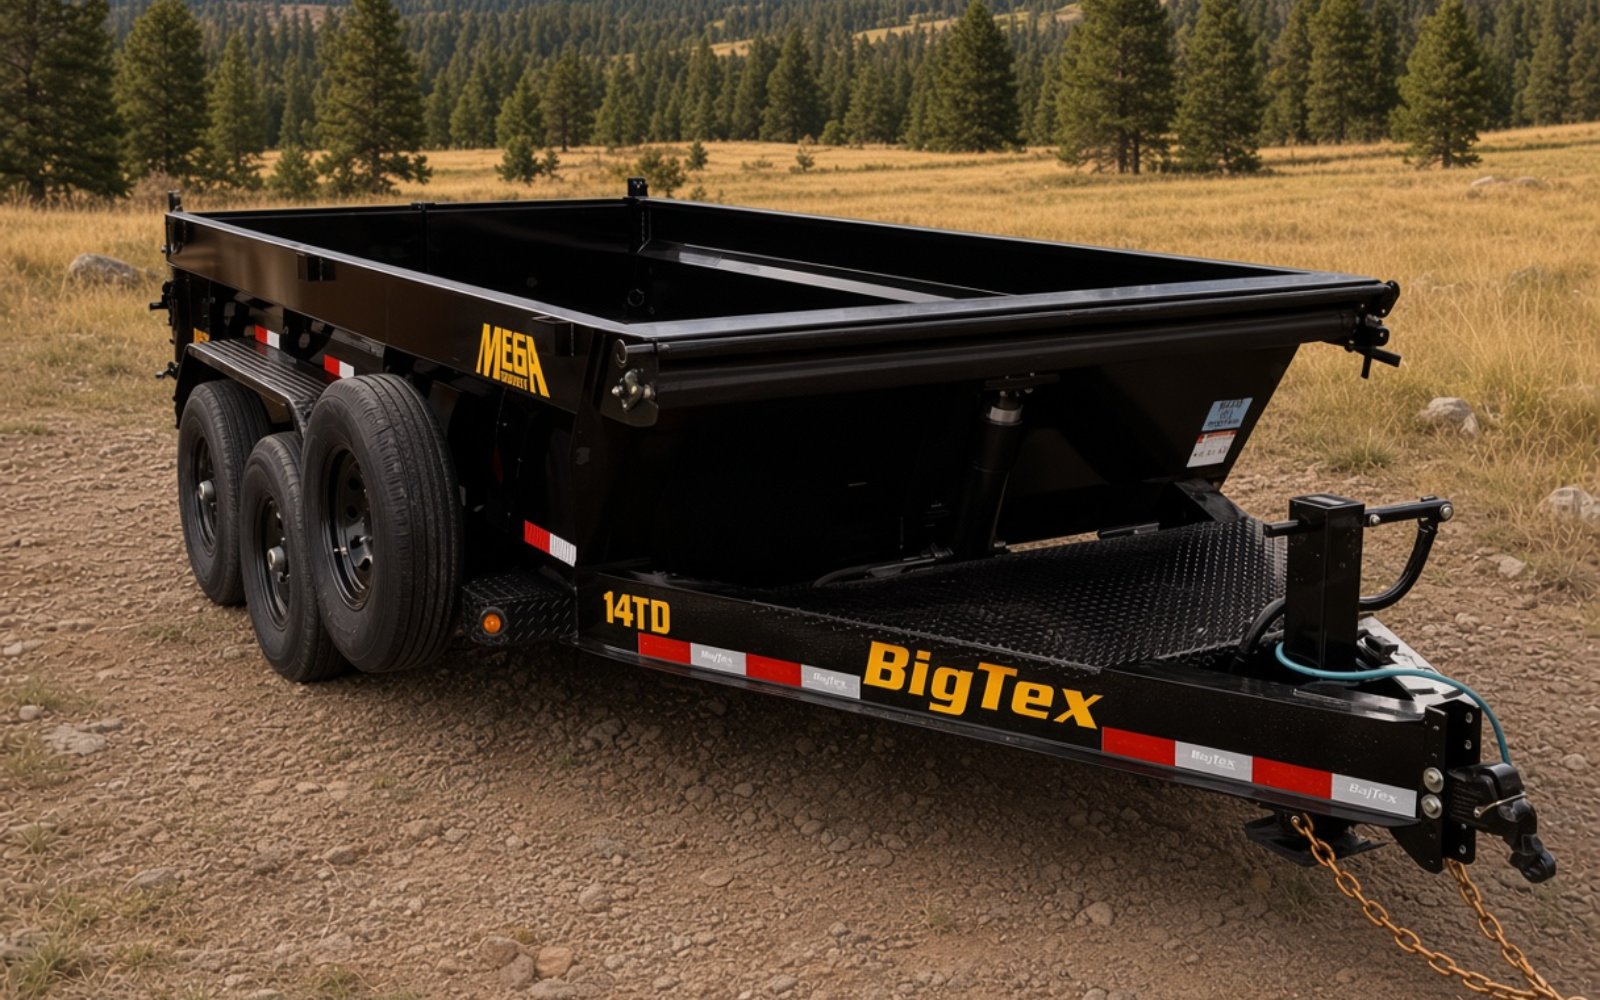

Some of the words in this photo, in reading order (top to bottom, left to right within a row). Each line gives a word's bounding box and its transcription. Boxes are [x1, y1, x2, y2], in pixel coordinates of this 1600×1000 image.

[476, 323, 550, 398] MEGA
[603, 591, 670, 634] 14TD
[863, 640, 1104, 729] BigTex
